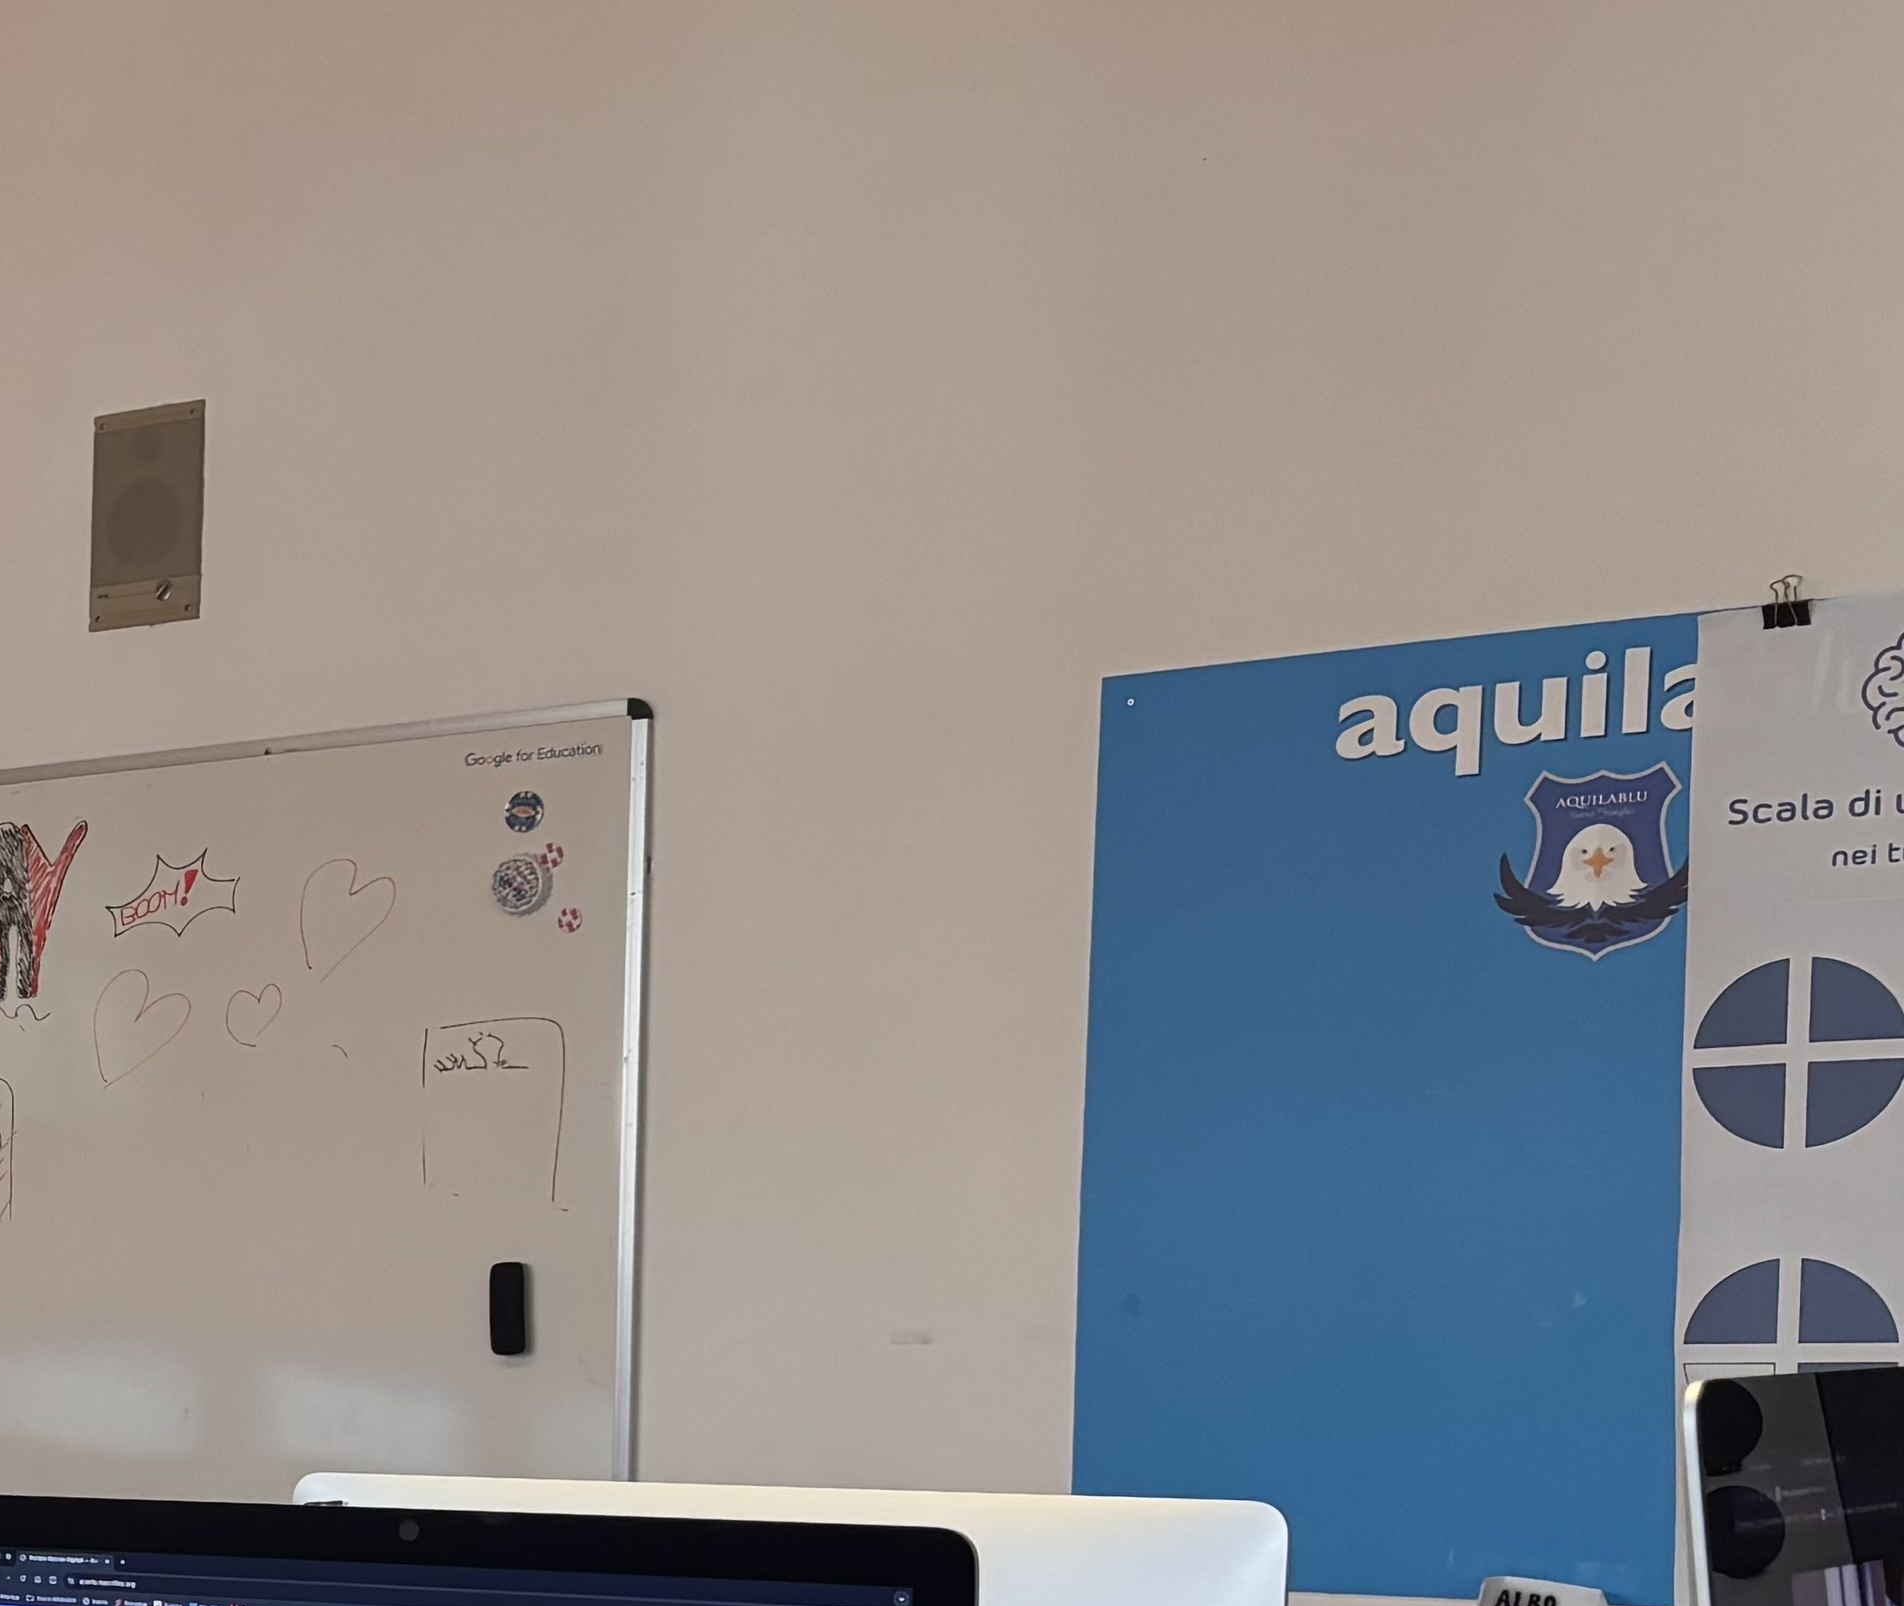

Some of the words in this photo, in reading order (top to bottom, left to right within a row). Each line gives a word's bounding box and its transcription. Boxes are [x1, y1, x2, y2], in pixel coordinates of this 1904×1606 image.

[465, 752, 513, 768] Google
[516, 749, 534, 761] for
[537, 743, 602, 760] Education
[1556, 791, 1648, 809] AQUILABLU
[1727, 793, 1834, 826] Scala
[1849, 788, 1881, 817] di
[1831, 843, 1878, 866] nei
[120, 869, 198, 926] BOOM!
